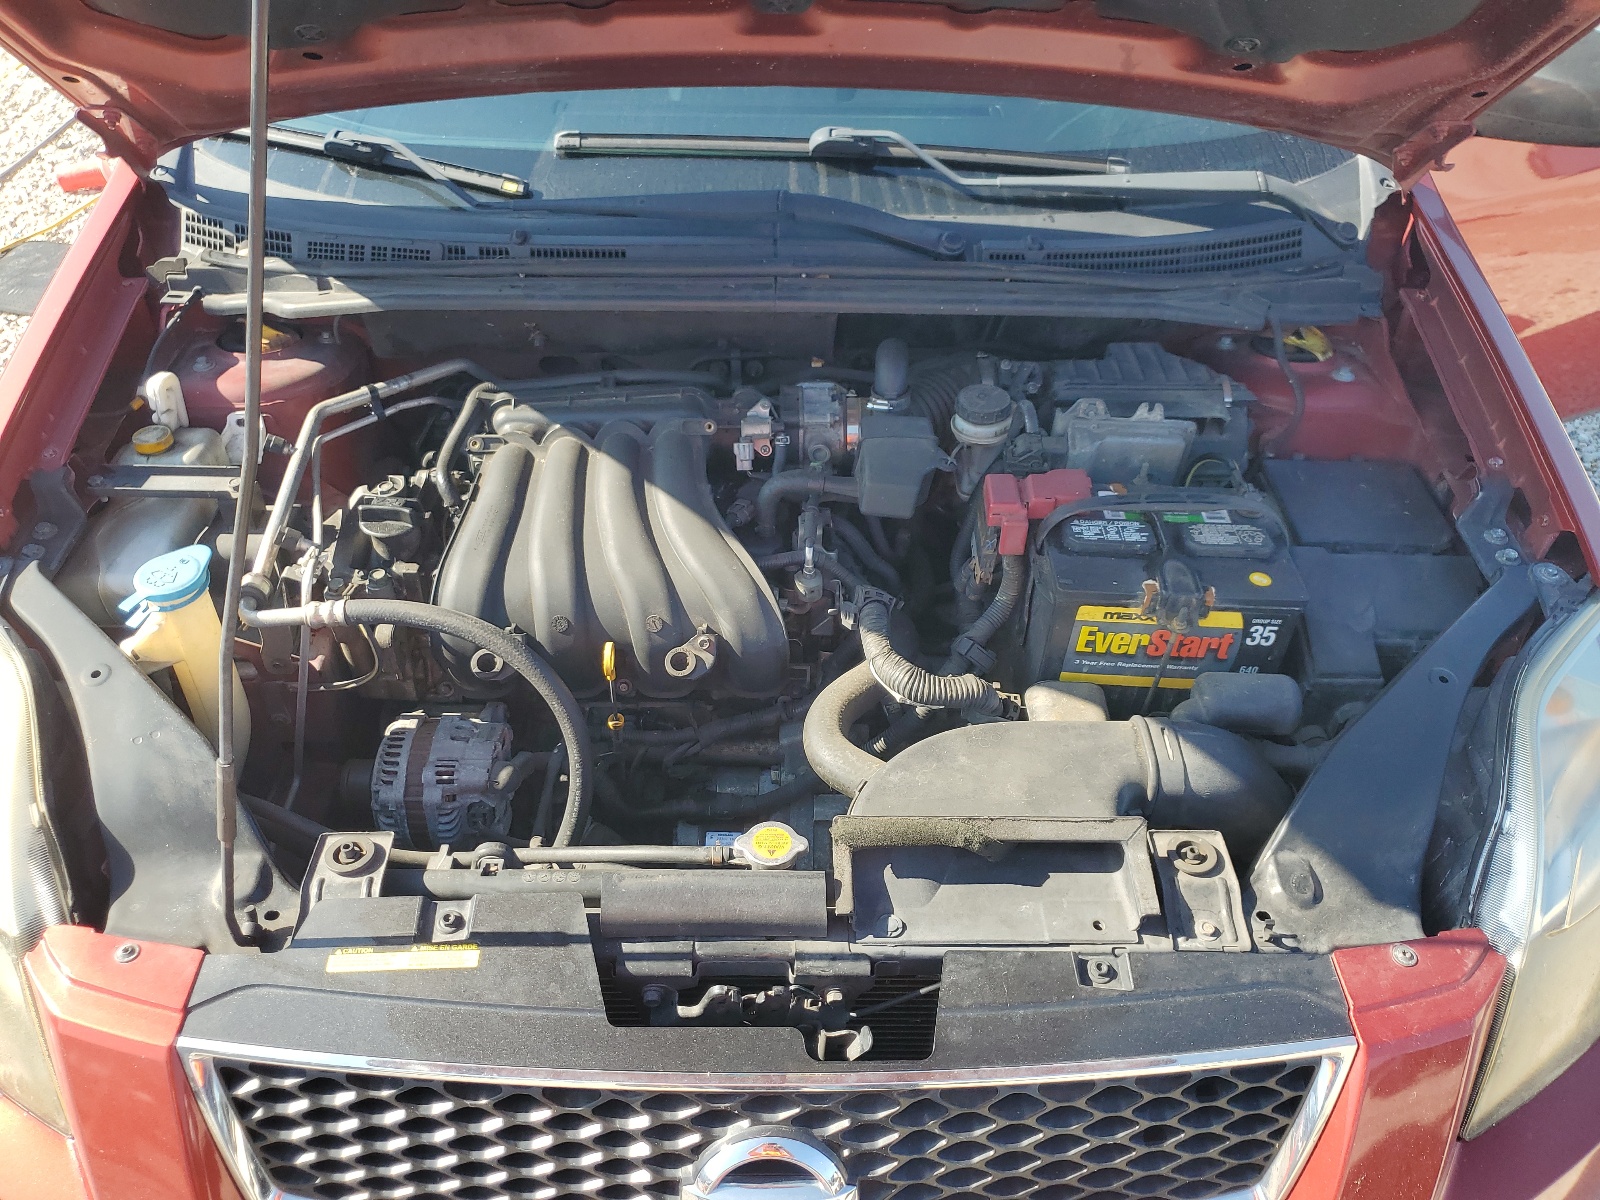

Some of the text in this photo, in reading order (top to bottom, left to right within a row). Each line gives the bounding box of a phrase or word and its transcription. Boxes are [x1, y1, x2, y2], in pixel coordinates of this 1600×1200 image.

[1075, 625, 1234, 660] EverStart
[1245, 625, 1279, 647] 35
[1116, 661, 1162, 669] Replacemen
[1166, 664, 1199, 672] Warranty
[1239, 665, 1260, 674] 640
